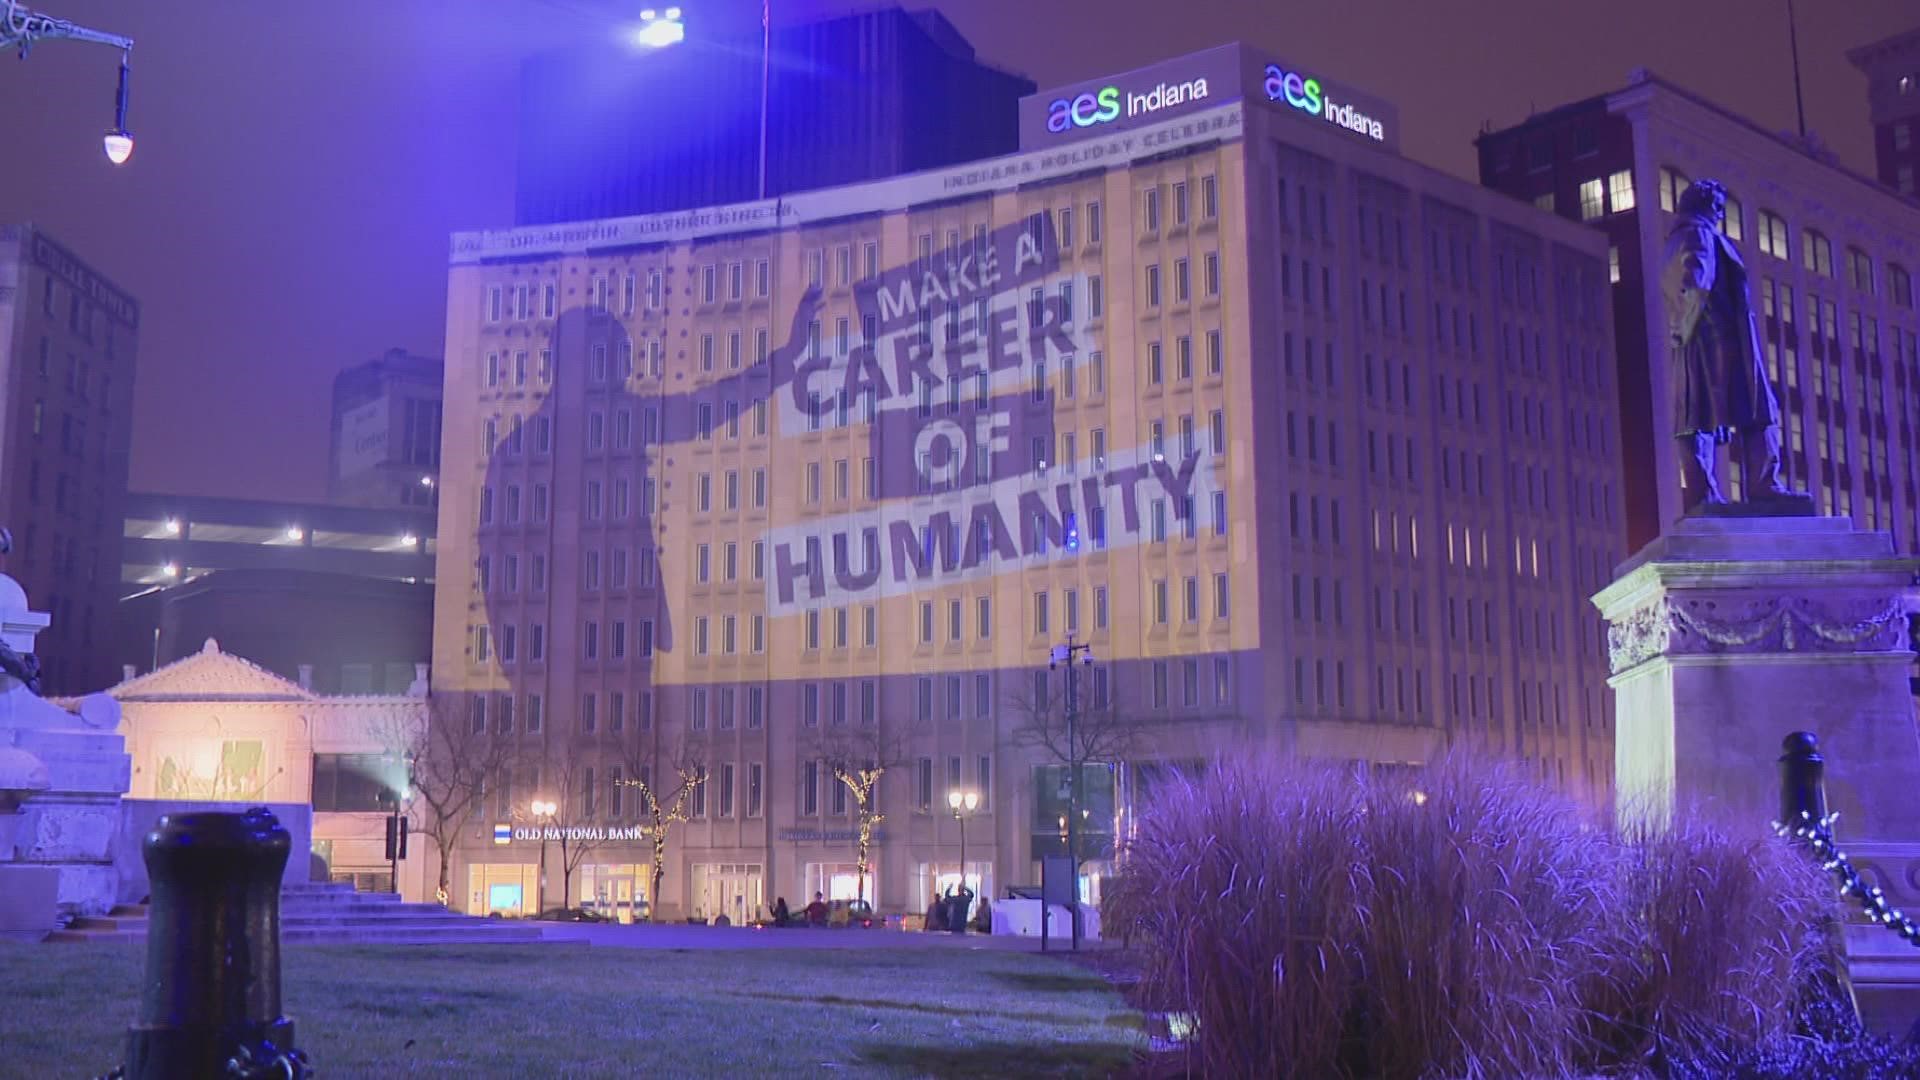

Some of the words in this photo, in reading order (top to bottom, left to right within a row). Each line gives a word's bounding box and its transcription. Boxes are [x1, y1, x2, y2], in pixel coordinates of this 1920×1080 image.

[1047, 86, 1121, 133] aes
[1127, 77, 1208, 118] Indiana
[1264, 65, 1322, 116] aes
[1324, 95, 1384, 141] Indiana
[943, 160, 1034, 189] INDIANA
[1041, 138, 1134, 170] HOLIDAY
[876, 247, 1001, 323] MAKE
[1014, 231, 1042, 275] A
[792, 294, 1078, 416] CAREER
[914, 411, 1010, 490] OF
[774, 448, 1201, 605] HUMANITY
[515, 827, 541, 840] OLD
[608, 825, 643, 840] BANK
